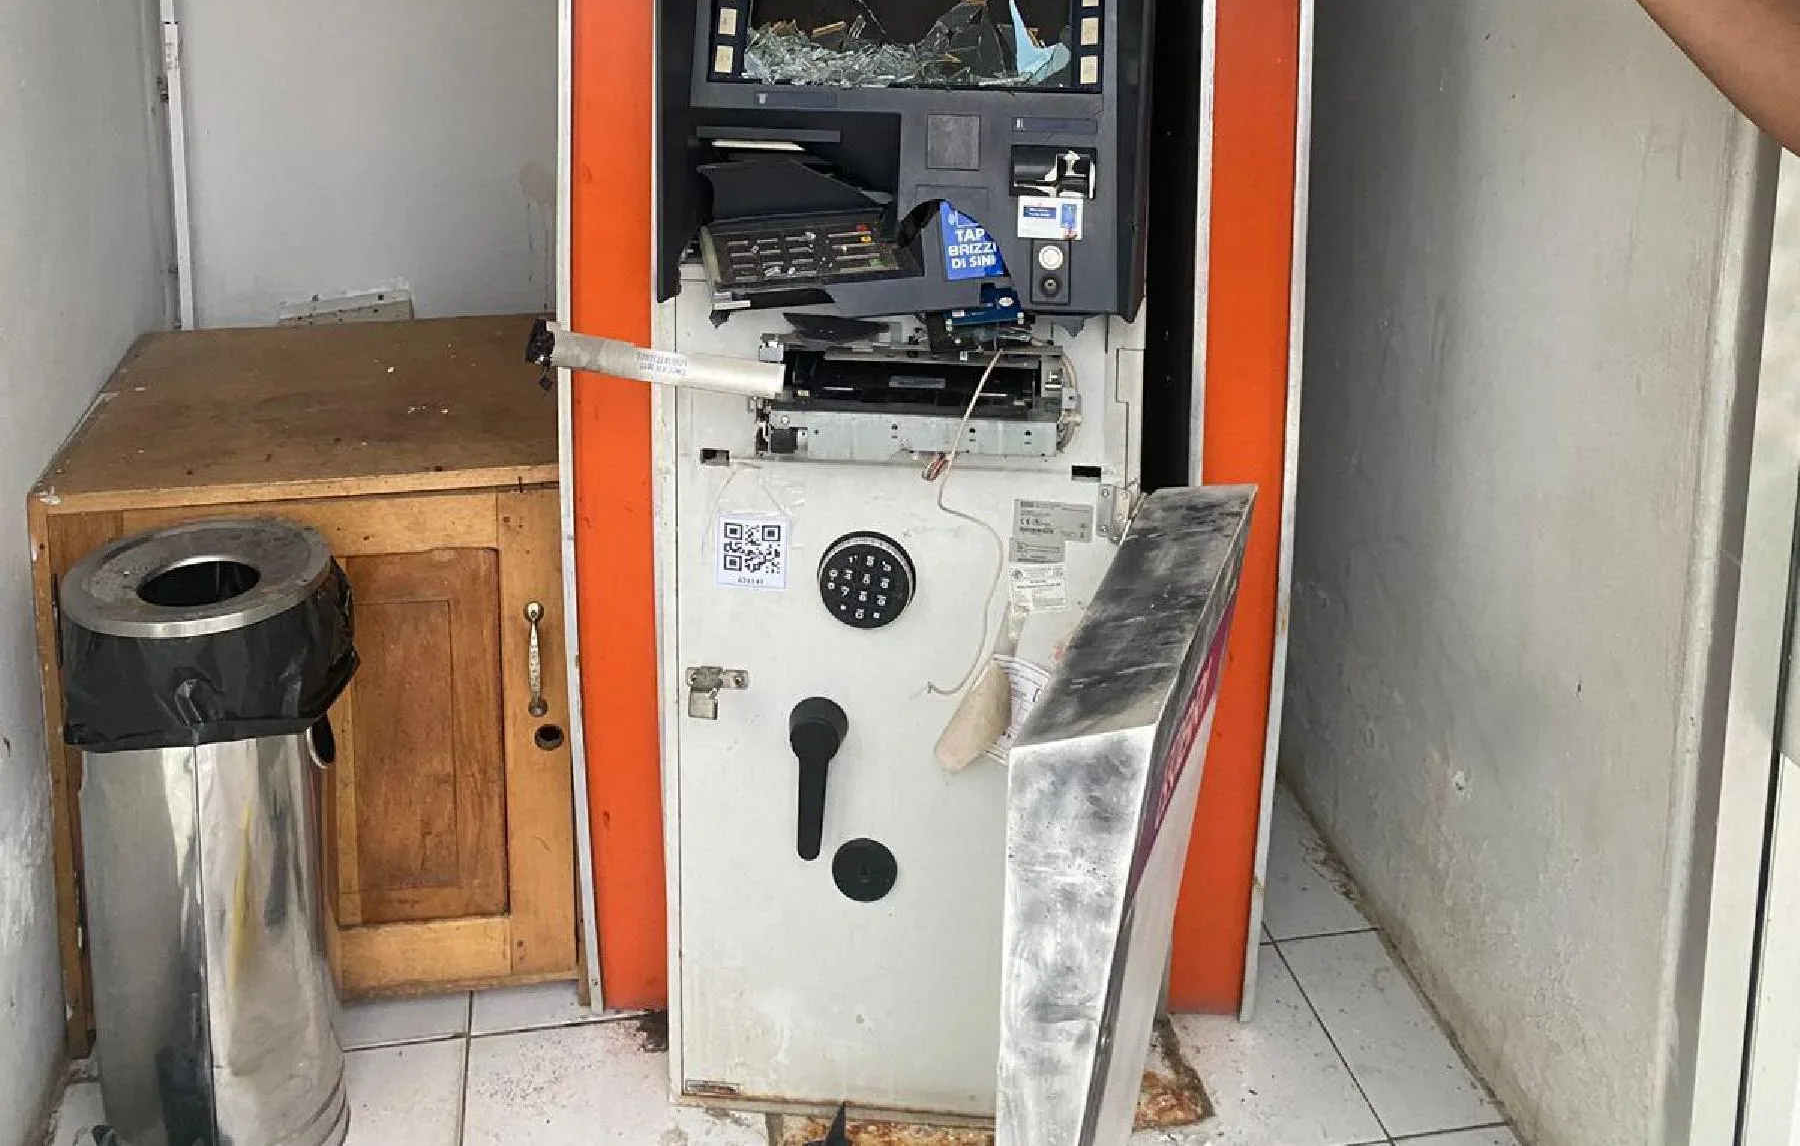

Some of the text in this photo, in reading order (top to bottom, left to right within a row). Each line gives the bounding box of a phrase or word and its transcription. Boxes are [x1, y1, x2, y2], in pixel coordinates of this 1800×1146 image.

[954, 228, 985, 242] TAP
[948, 241, 997, 257] BRIZZI
[951, 254, 997, 269] DI SINI
